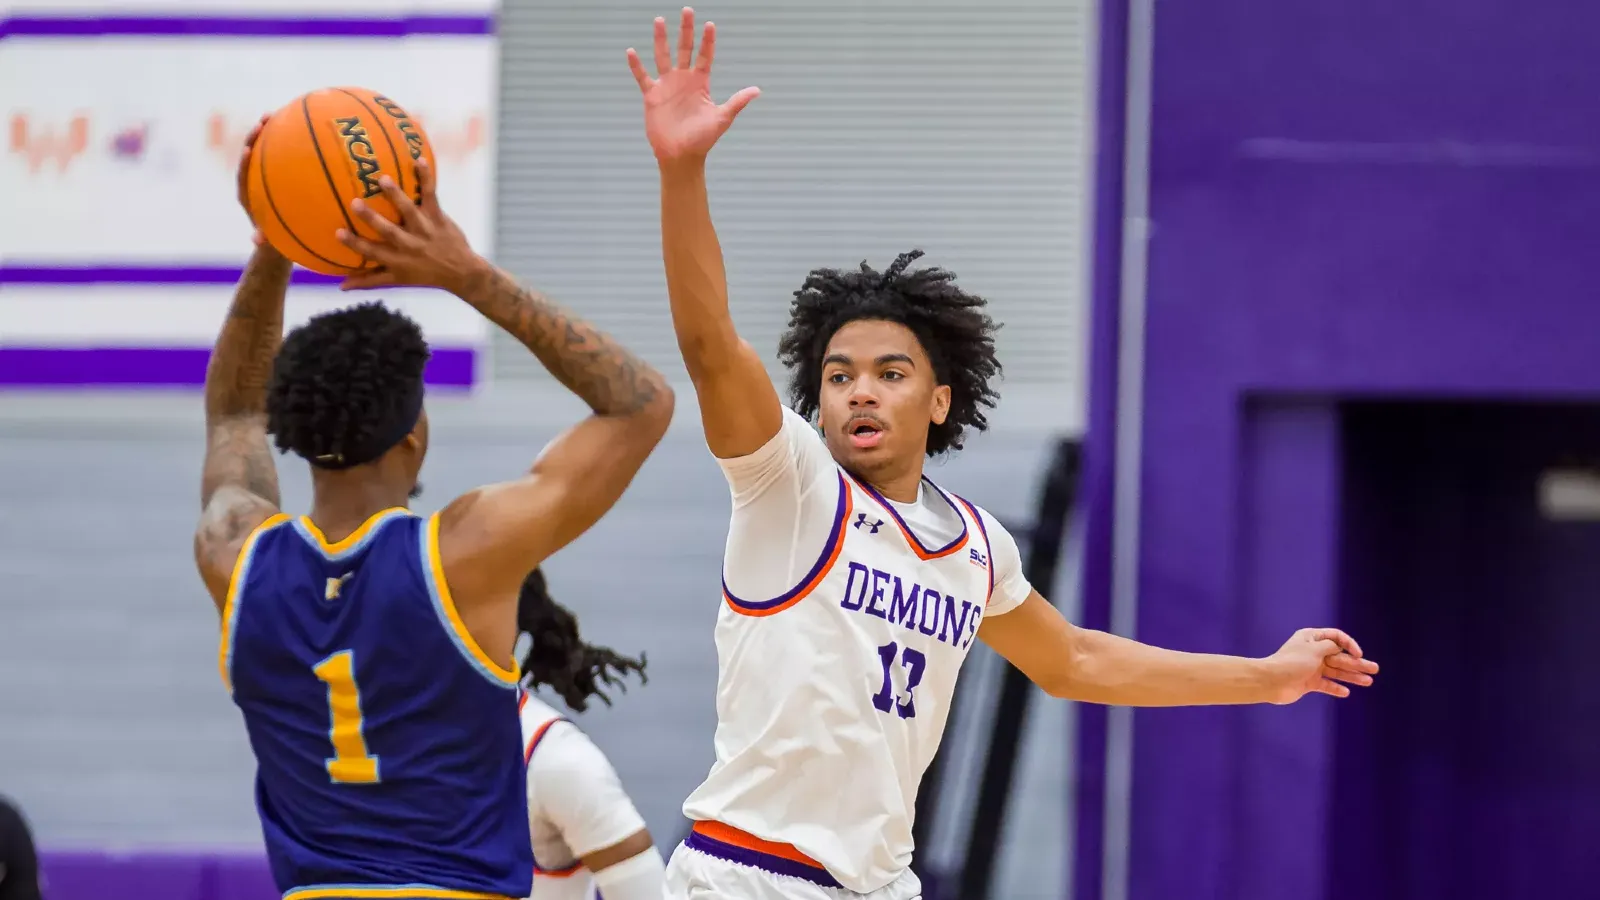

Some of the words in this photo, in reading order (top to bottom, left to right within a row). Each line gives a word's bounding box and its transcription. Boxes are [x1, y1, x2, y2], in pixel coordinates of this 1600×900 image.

[334, 116, 382, 198] NCAA
[373, 96, 422, 206] Wils
[840, 561, 981, 650] DEMONS
[312, 648, 381, 784] 1
[872, 641, 926, 719] 13
